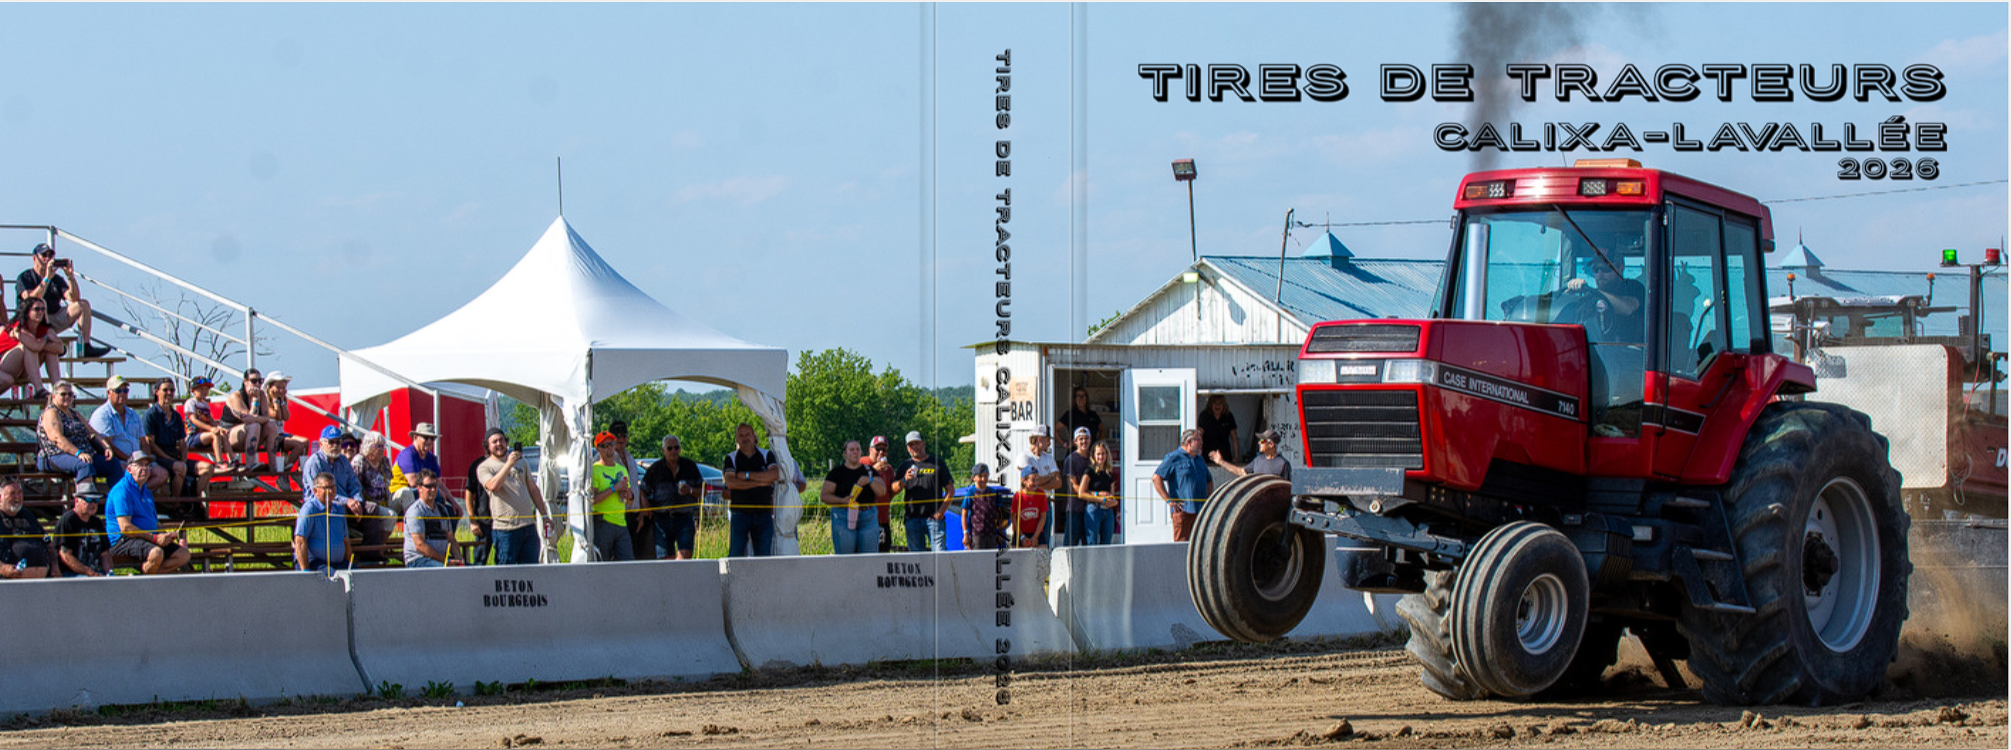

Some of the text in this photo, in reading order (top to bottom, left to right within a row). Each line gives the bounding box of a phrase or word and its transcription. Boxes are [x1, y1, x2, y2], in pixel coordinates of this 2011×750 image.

[1443, 371, 1575, 416] CASE INTERNATIONAL 7140
[1011, 400, 1033, 421] BAR
[495, 579, 534, 593] BETON
[483, 594, 548, 608] BOURGEOIS
